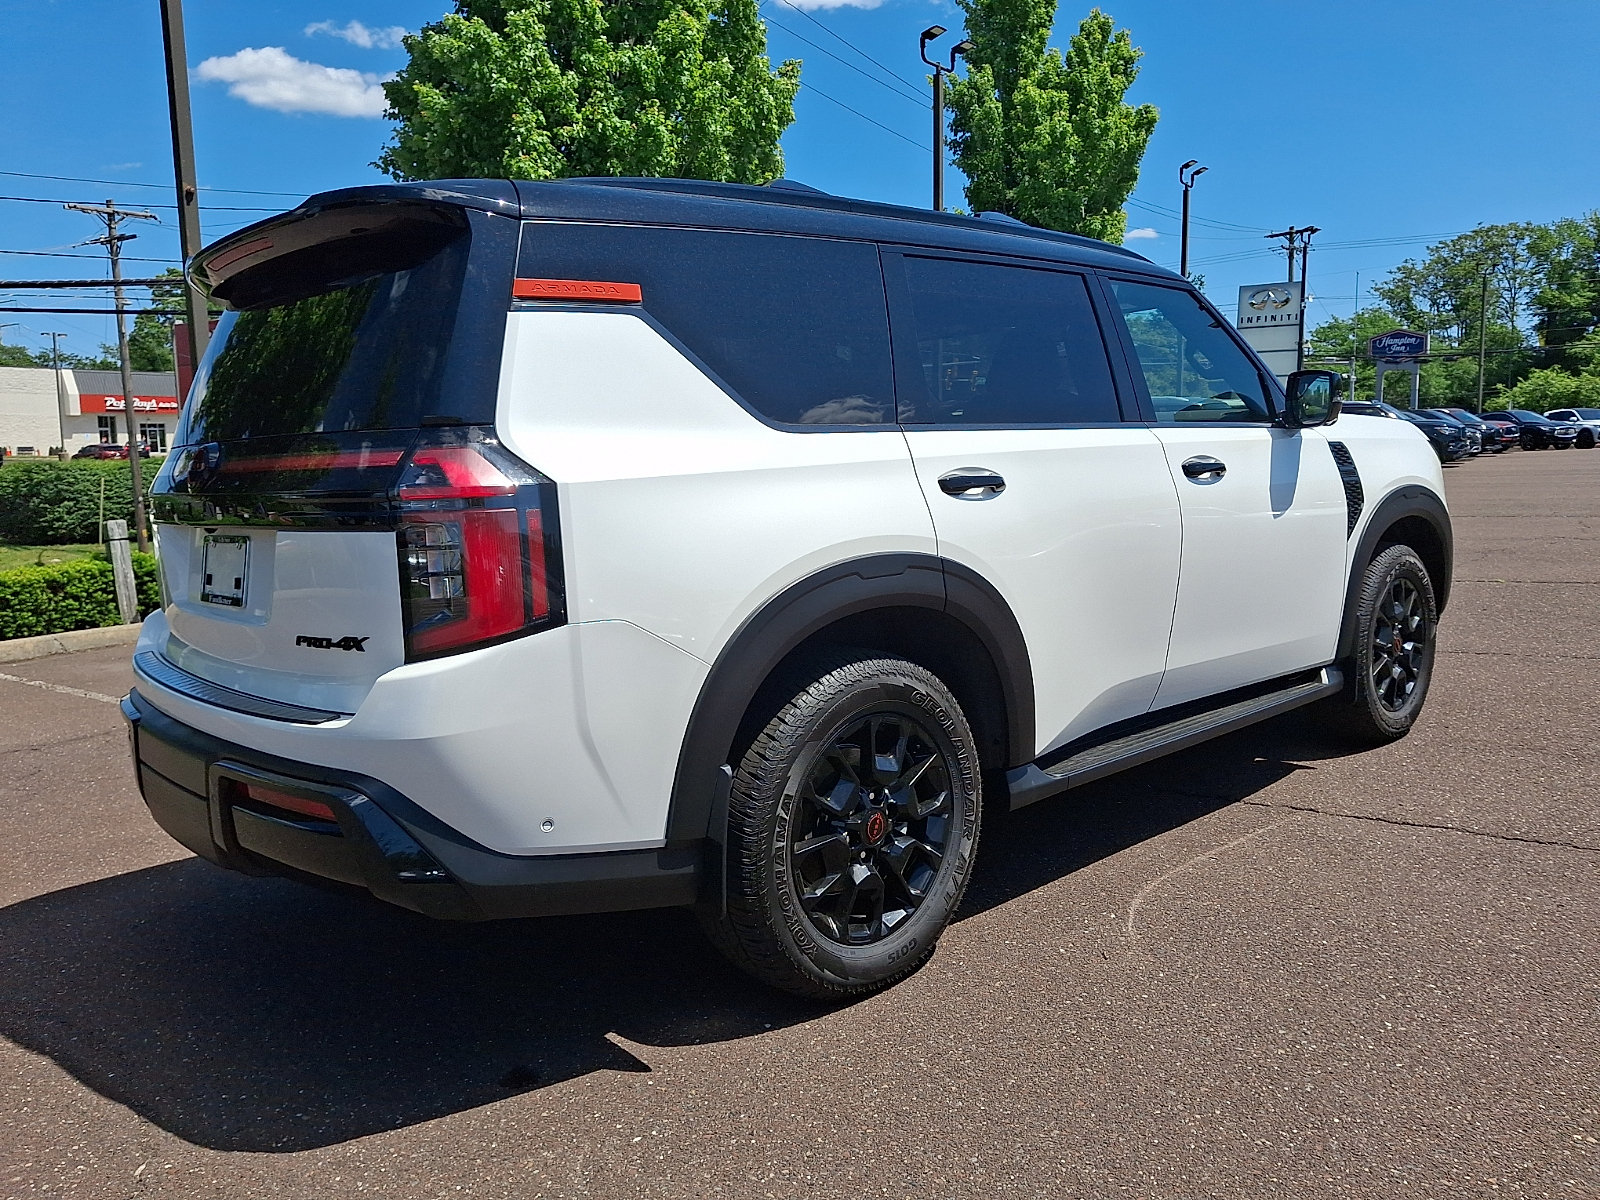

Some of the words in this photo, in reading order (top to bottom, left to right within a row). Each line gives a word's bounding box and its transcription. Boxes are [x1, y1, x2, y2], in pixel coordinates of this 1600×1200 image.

[530, 283, 621, 295] ARMADA
[1240, 313, 1298, 324] INFINITI
[1376, 336, 1420, 348] Hampton
[1386, 344, 1410, 354] Inn
[295, 635, 371, 652] PRO-4X
[910, 690, 977, 842] GEOLANDAR
[772, 792, 818, 961] YOKOHAMA
